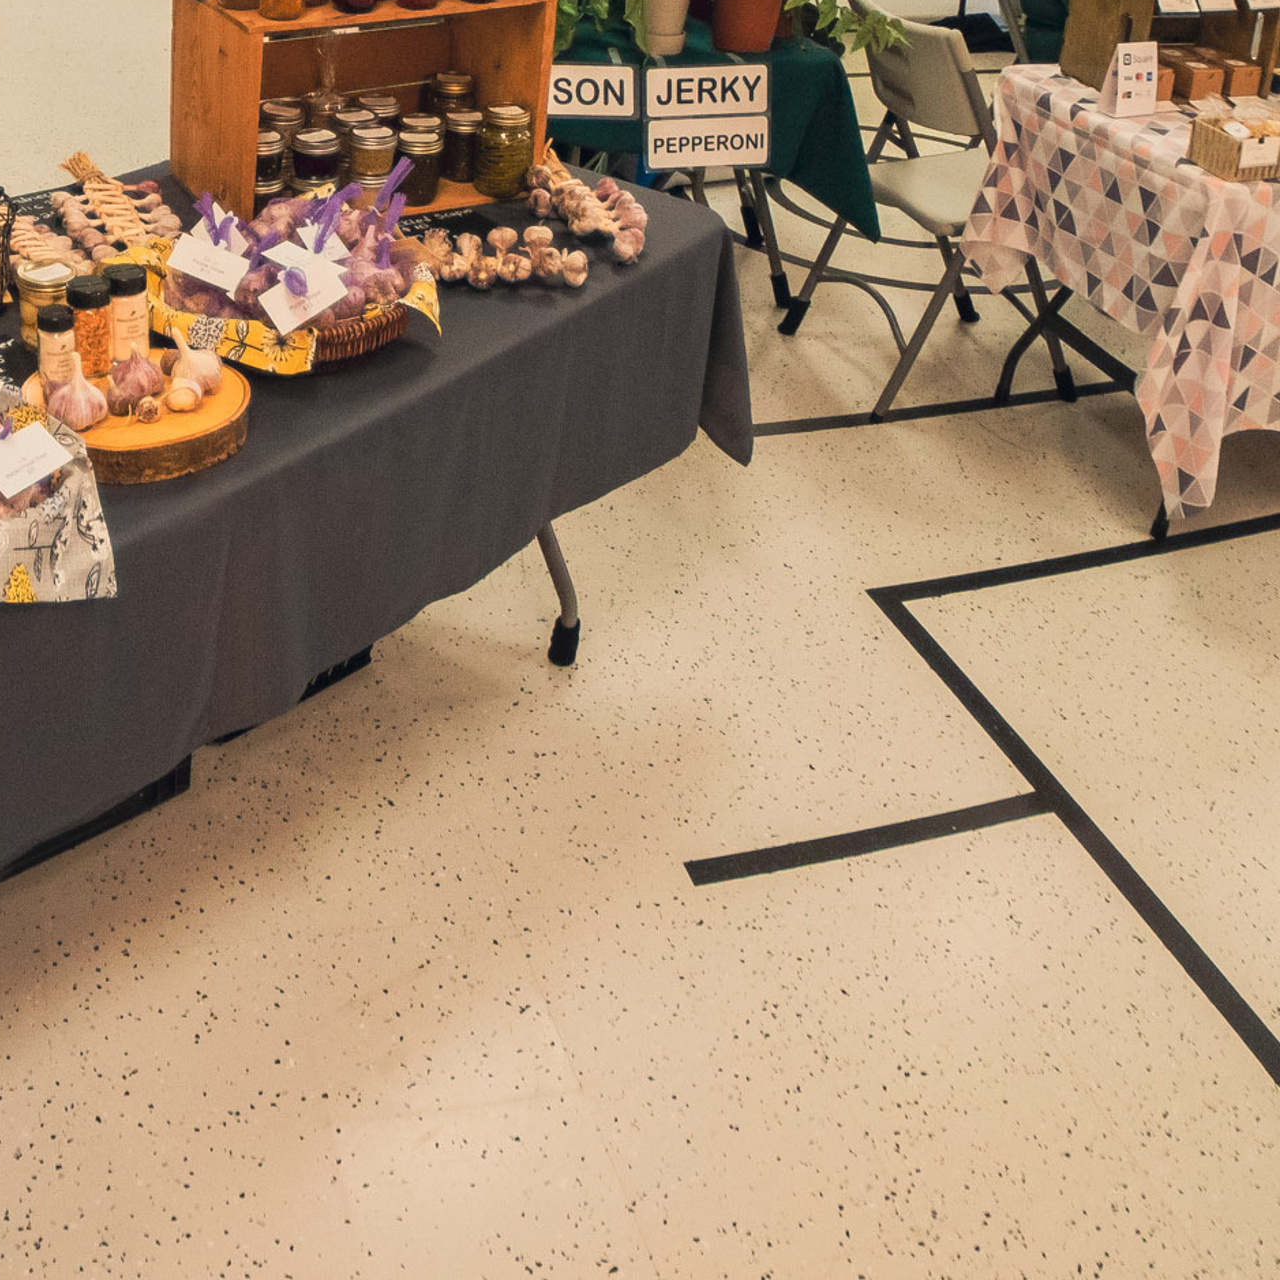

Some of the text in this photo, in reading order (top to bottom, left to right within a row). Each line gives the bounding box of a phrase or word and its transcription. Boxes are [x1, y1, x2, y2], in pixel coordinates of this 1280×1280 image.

[552, 77, 625, 106] SON
[656, 75, 762, 106] JERKY
[653, 133, 764, 154] PEPPERONI
